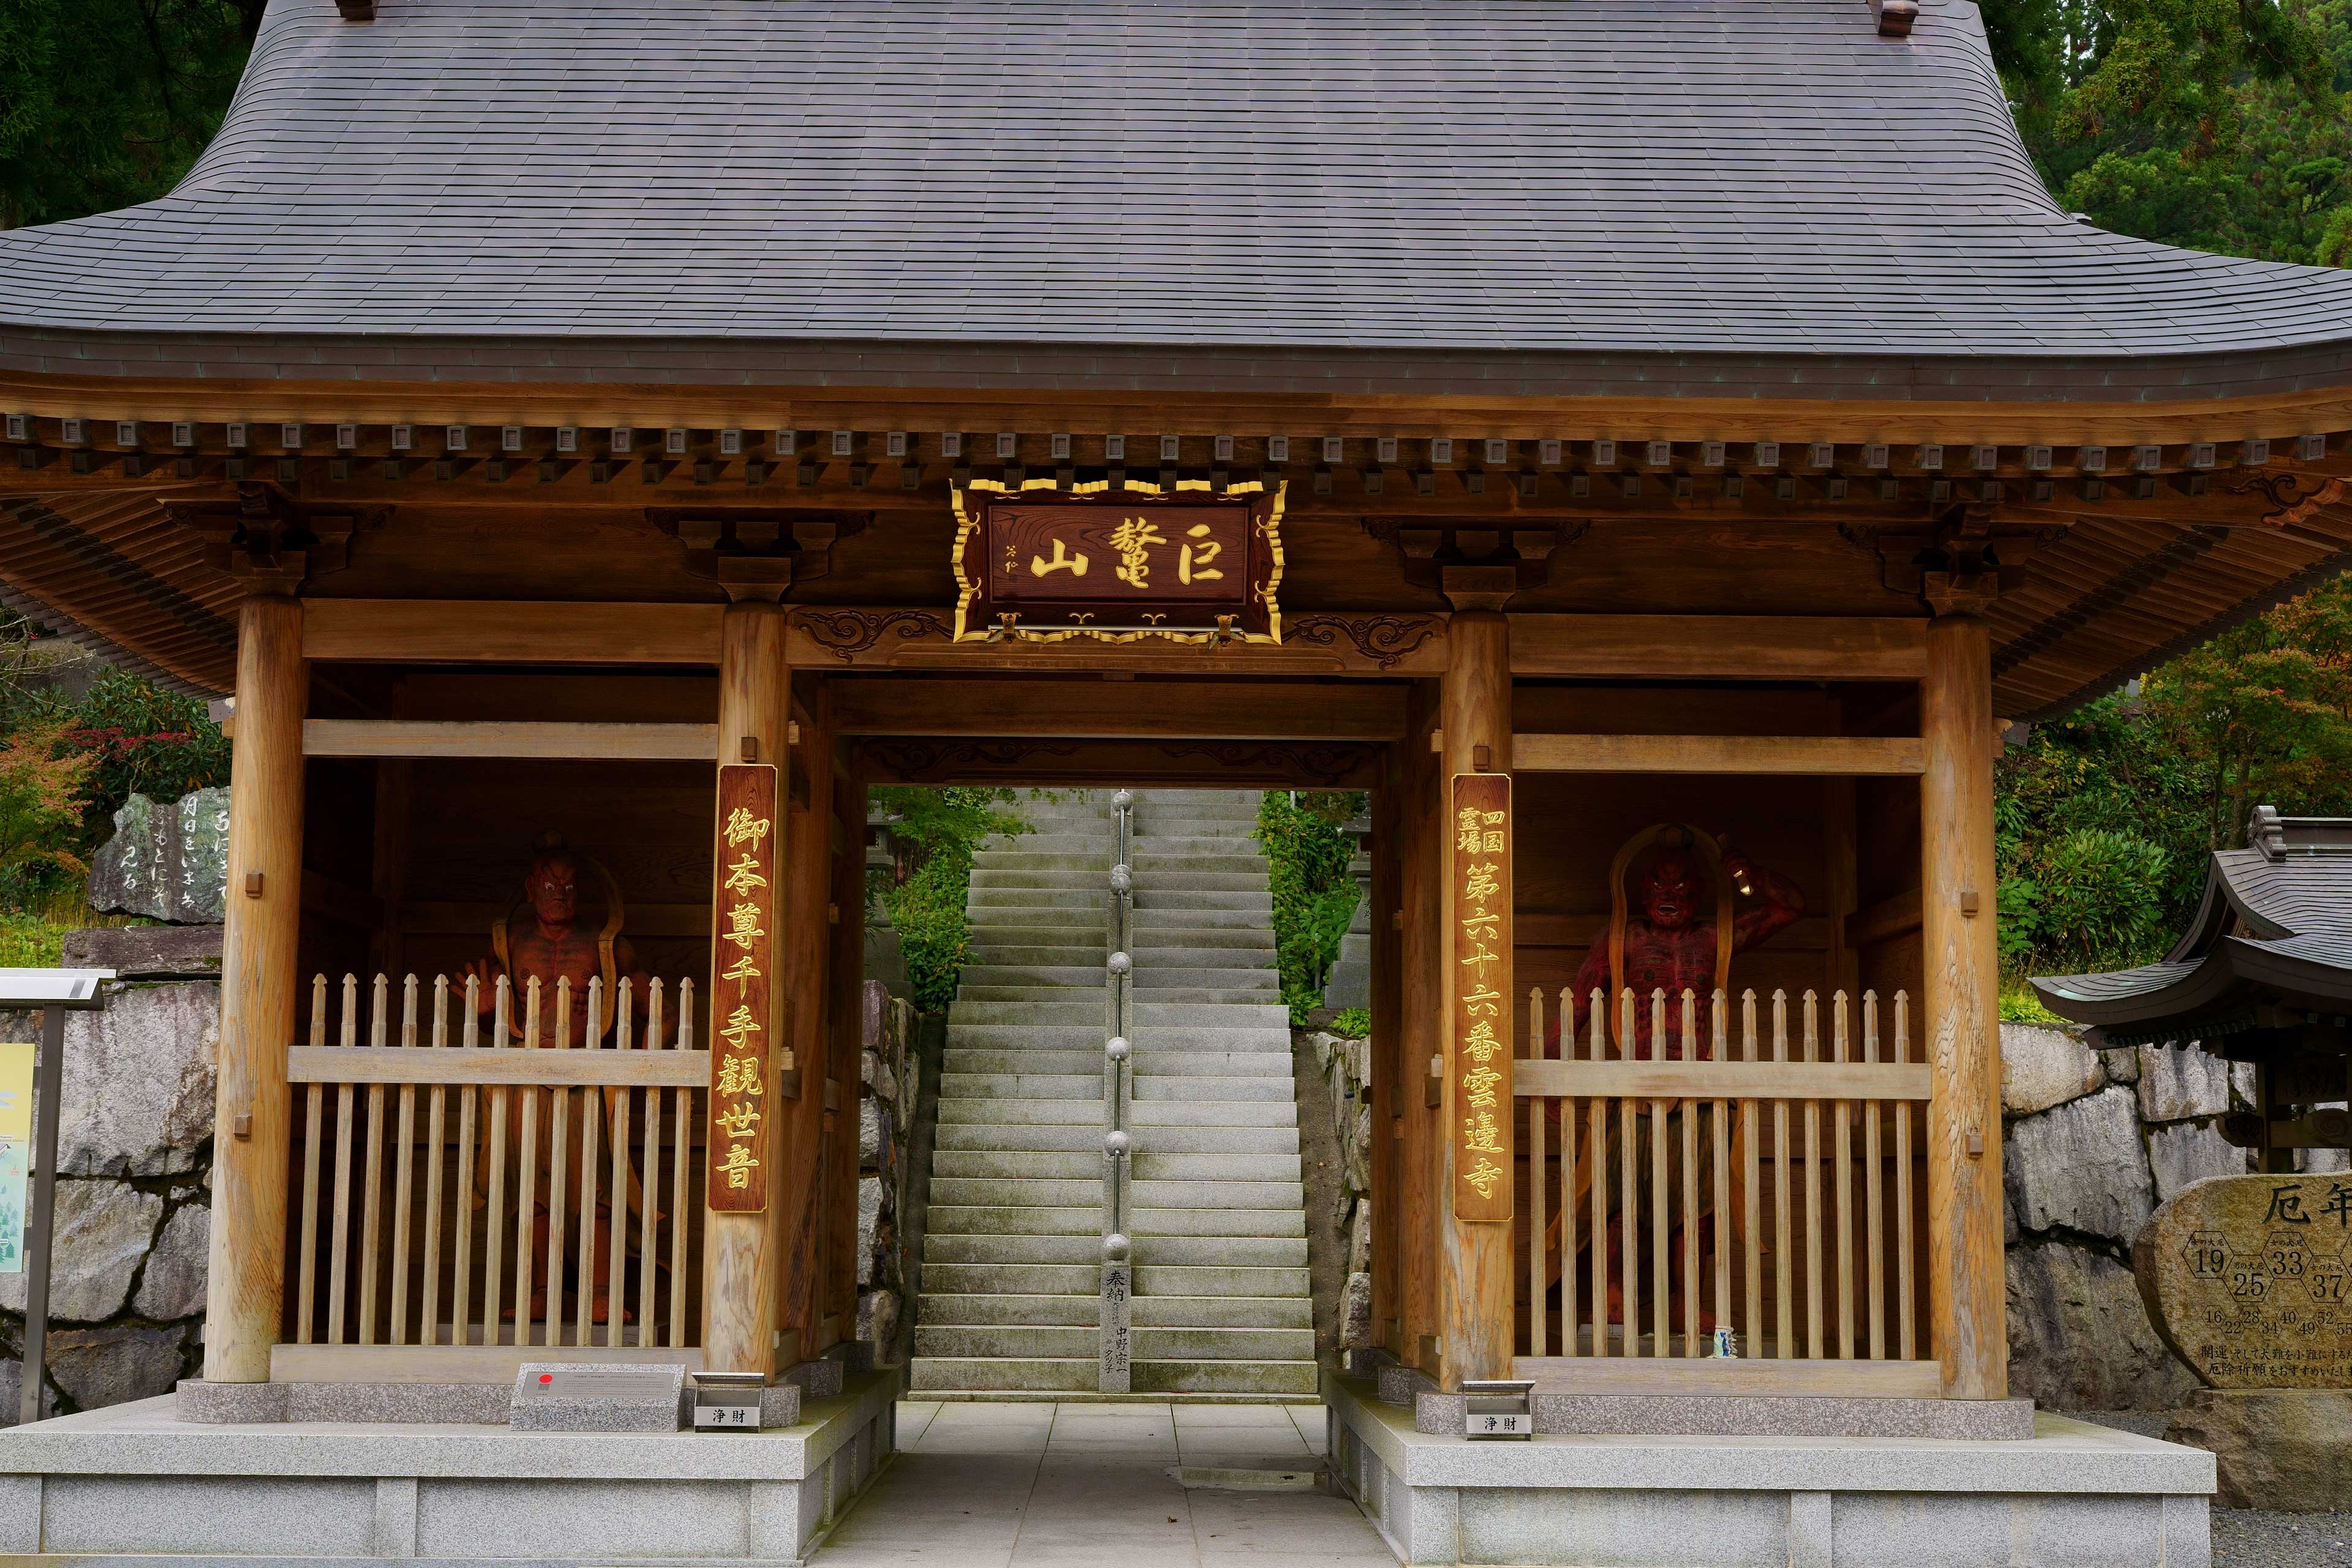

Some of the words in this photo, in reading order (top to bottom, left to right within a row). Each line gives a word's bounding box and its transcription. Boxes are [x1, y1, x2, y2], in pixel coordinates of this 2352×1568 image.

[1482, 811, 1505, 853] 四国
[2261, 1182, 2352, 1228] 厄年
[2196, 1249, 2225, 1273] 19
[2273, 1251, 2303, 1275] 33
[2310, 1263, 2343, 1272] 女の大厄
[1107, 1270, 1125, 1302] 奉納
[2233, 1273, 2264, 1297] 25
[2313, 1274, 2343, 1298] 37
[2206, 1310, 2222, 1323] 16
[2243, 1311, 2260, 1324] 28
[2280, 1311, 2296, 1324] 40
[2317, 1311, 2334, 1324] 52
[2225, 1321, 2241, 1334] 22
[2262, 1322, 2278, 1335] 34
[2299, 1322, 2315, 1335] 49
[2337, 1322, 2352, 1335] 55
[1116, 1327, 1127, 1371] 中野宗一
[713, 1409, 745, 1423] 浄財
[1485, 1416, 1517, 1431] 浄財
